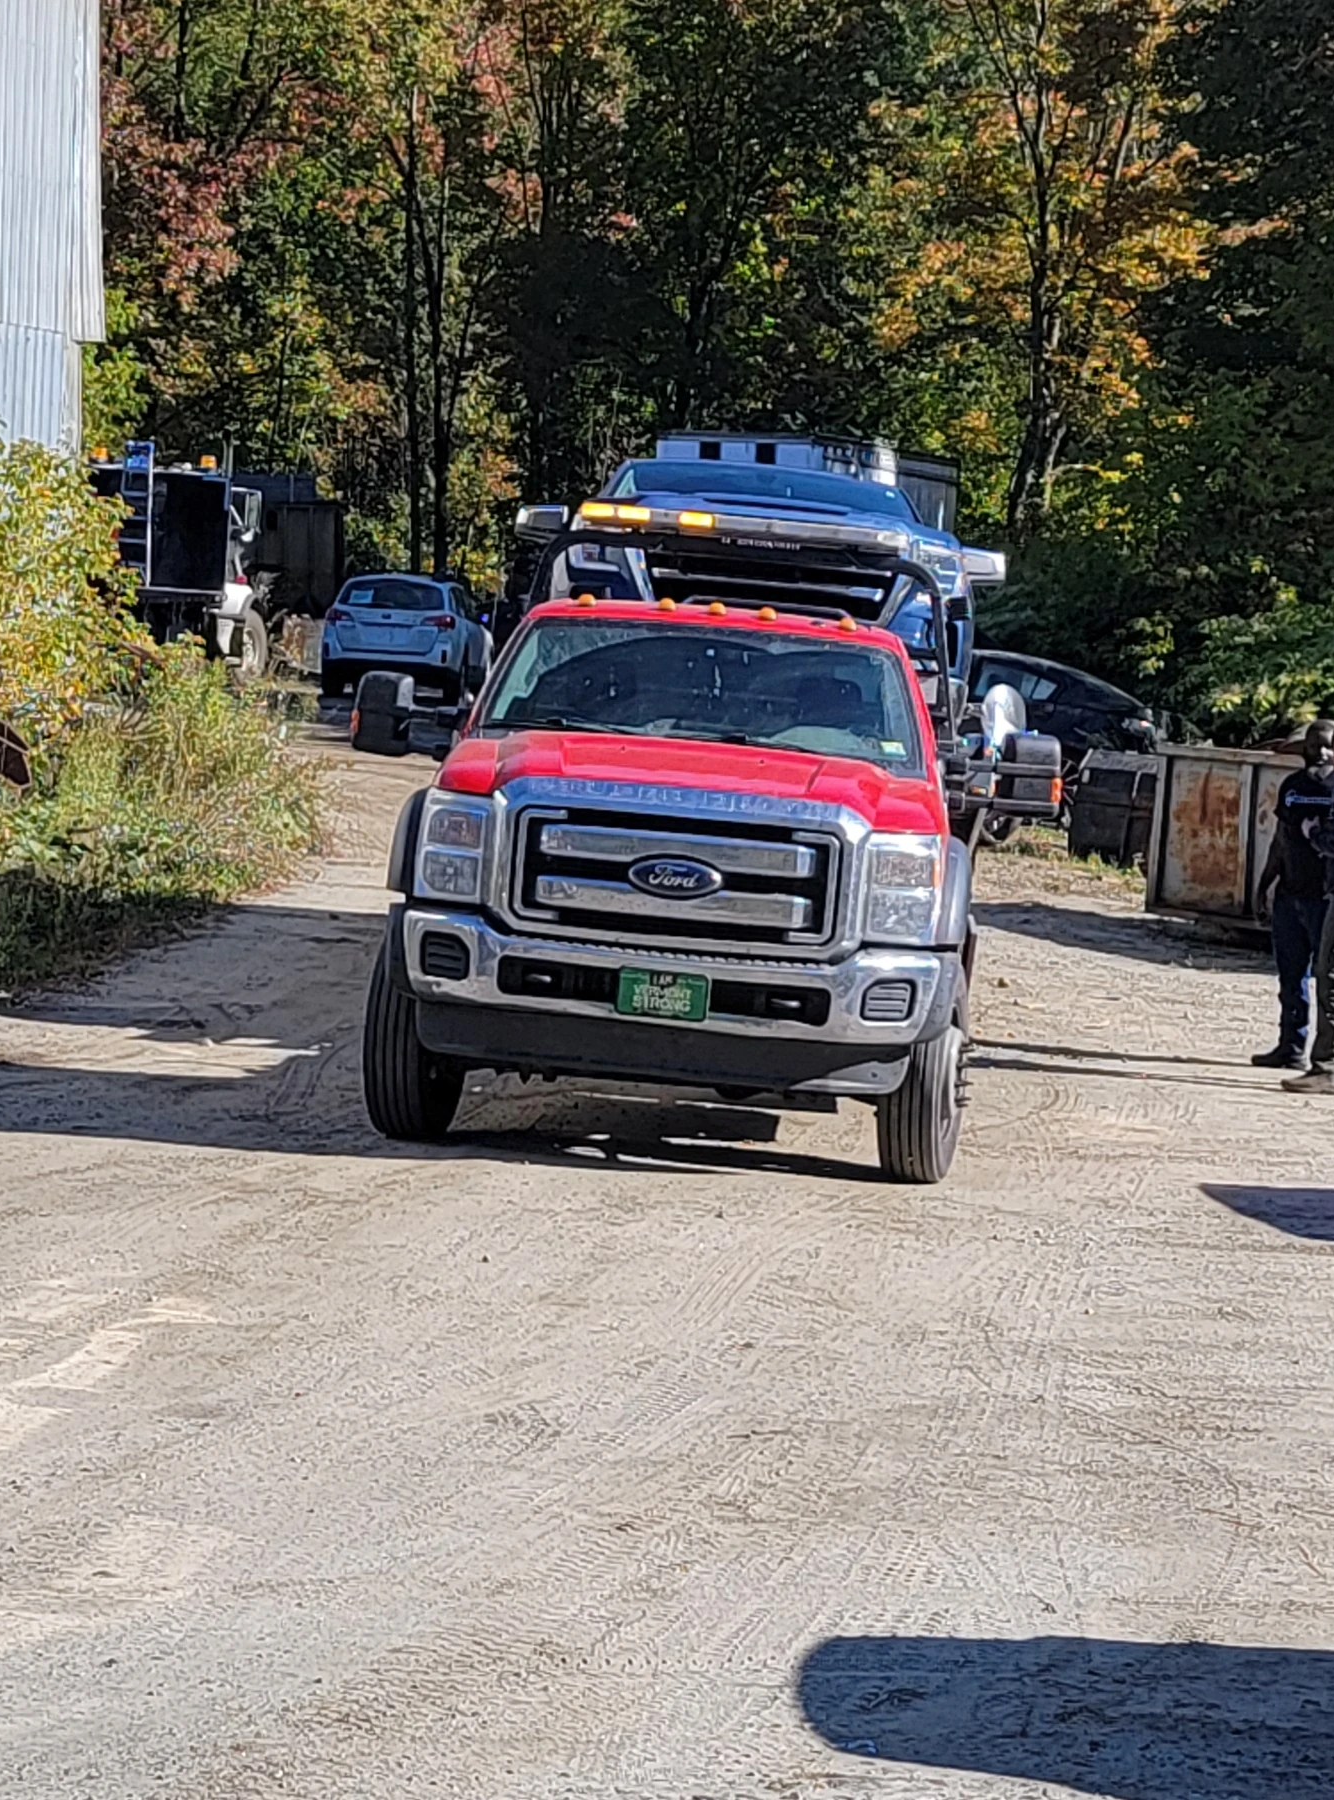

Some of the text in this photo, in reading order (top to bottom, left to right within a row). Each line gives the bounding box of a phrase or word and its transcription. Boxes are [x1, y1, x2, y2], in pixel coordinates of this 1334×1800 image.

[648, 864, 701, 888] Ford
[633, 984, 693, 999] VERMONT
[631, 994, 692, 1012] STRONG
